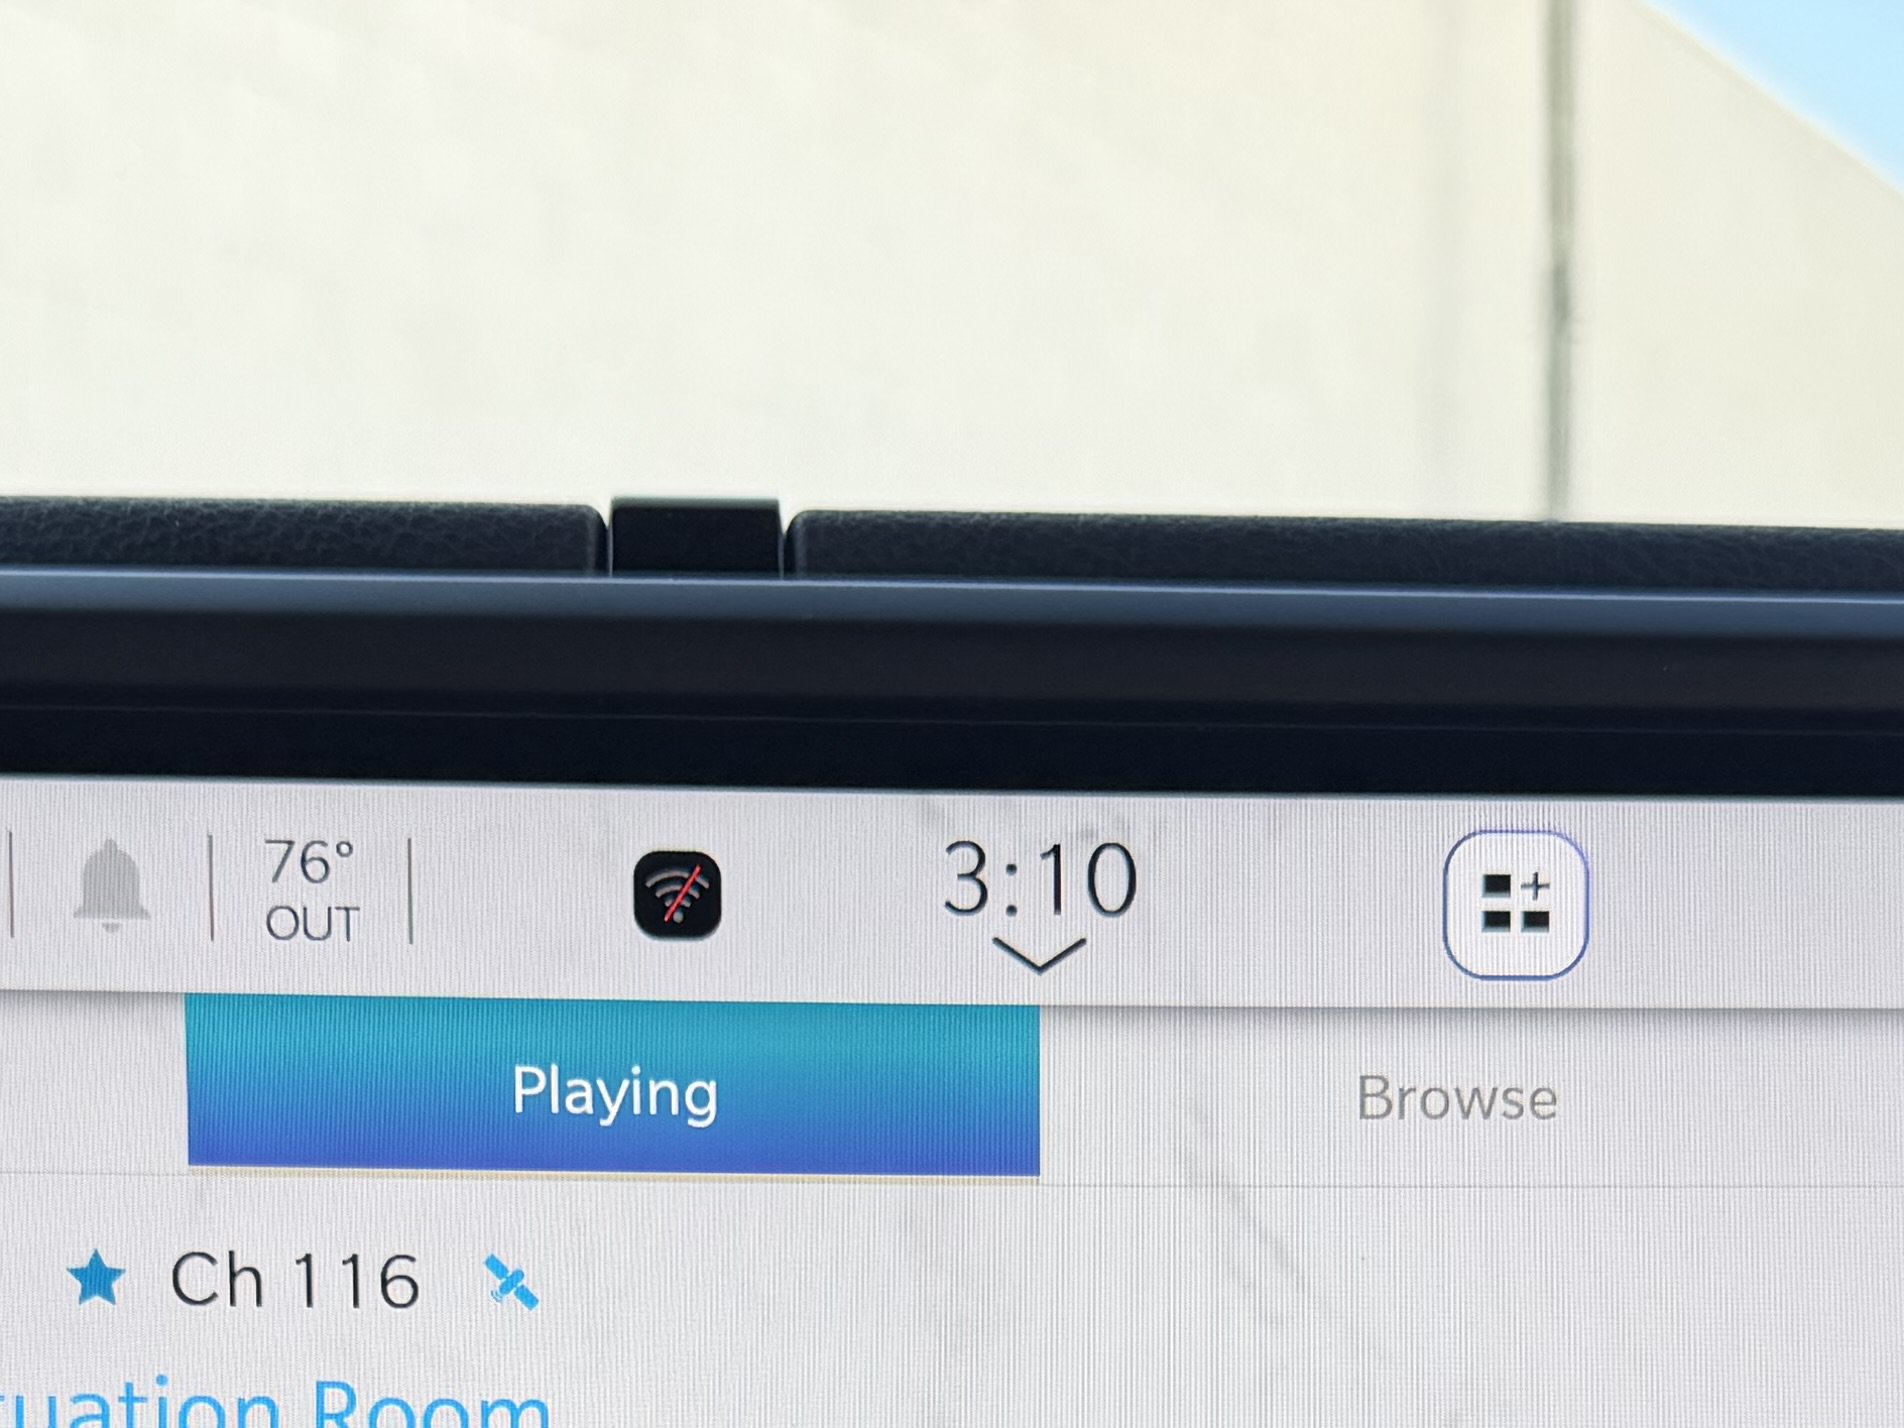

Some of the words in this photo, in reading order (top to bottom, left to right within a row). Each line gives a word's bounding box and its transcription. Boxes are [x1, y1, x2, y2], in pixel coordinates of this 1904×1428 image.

[264, 839, 354, 884] 76°
[944, 840, 1138, 917] 3:10
[265, 905, 361, 942] OUT
[513, 1066, 718, 1128] Playing
[1359, 1074, 1558, 1121] Browse
[172, 1251, 263, 1309] Ch
[296, 1253, 420, 1310] 116
